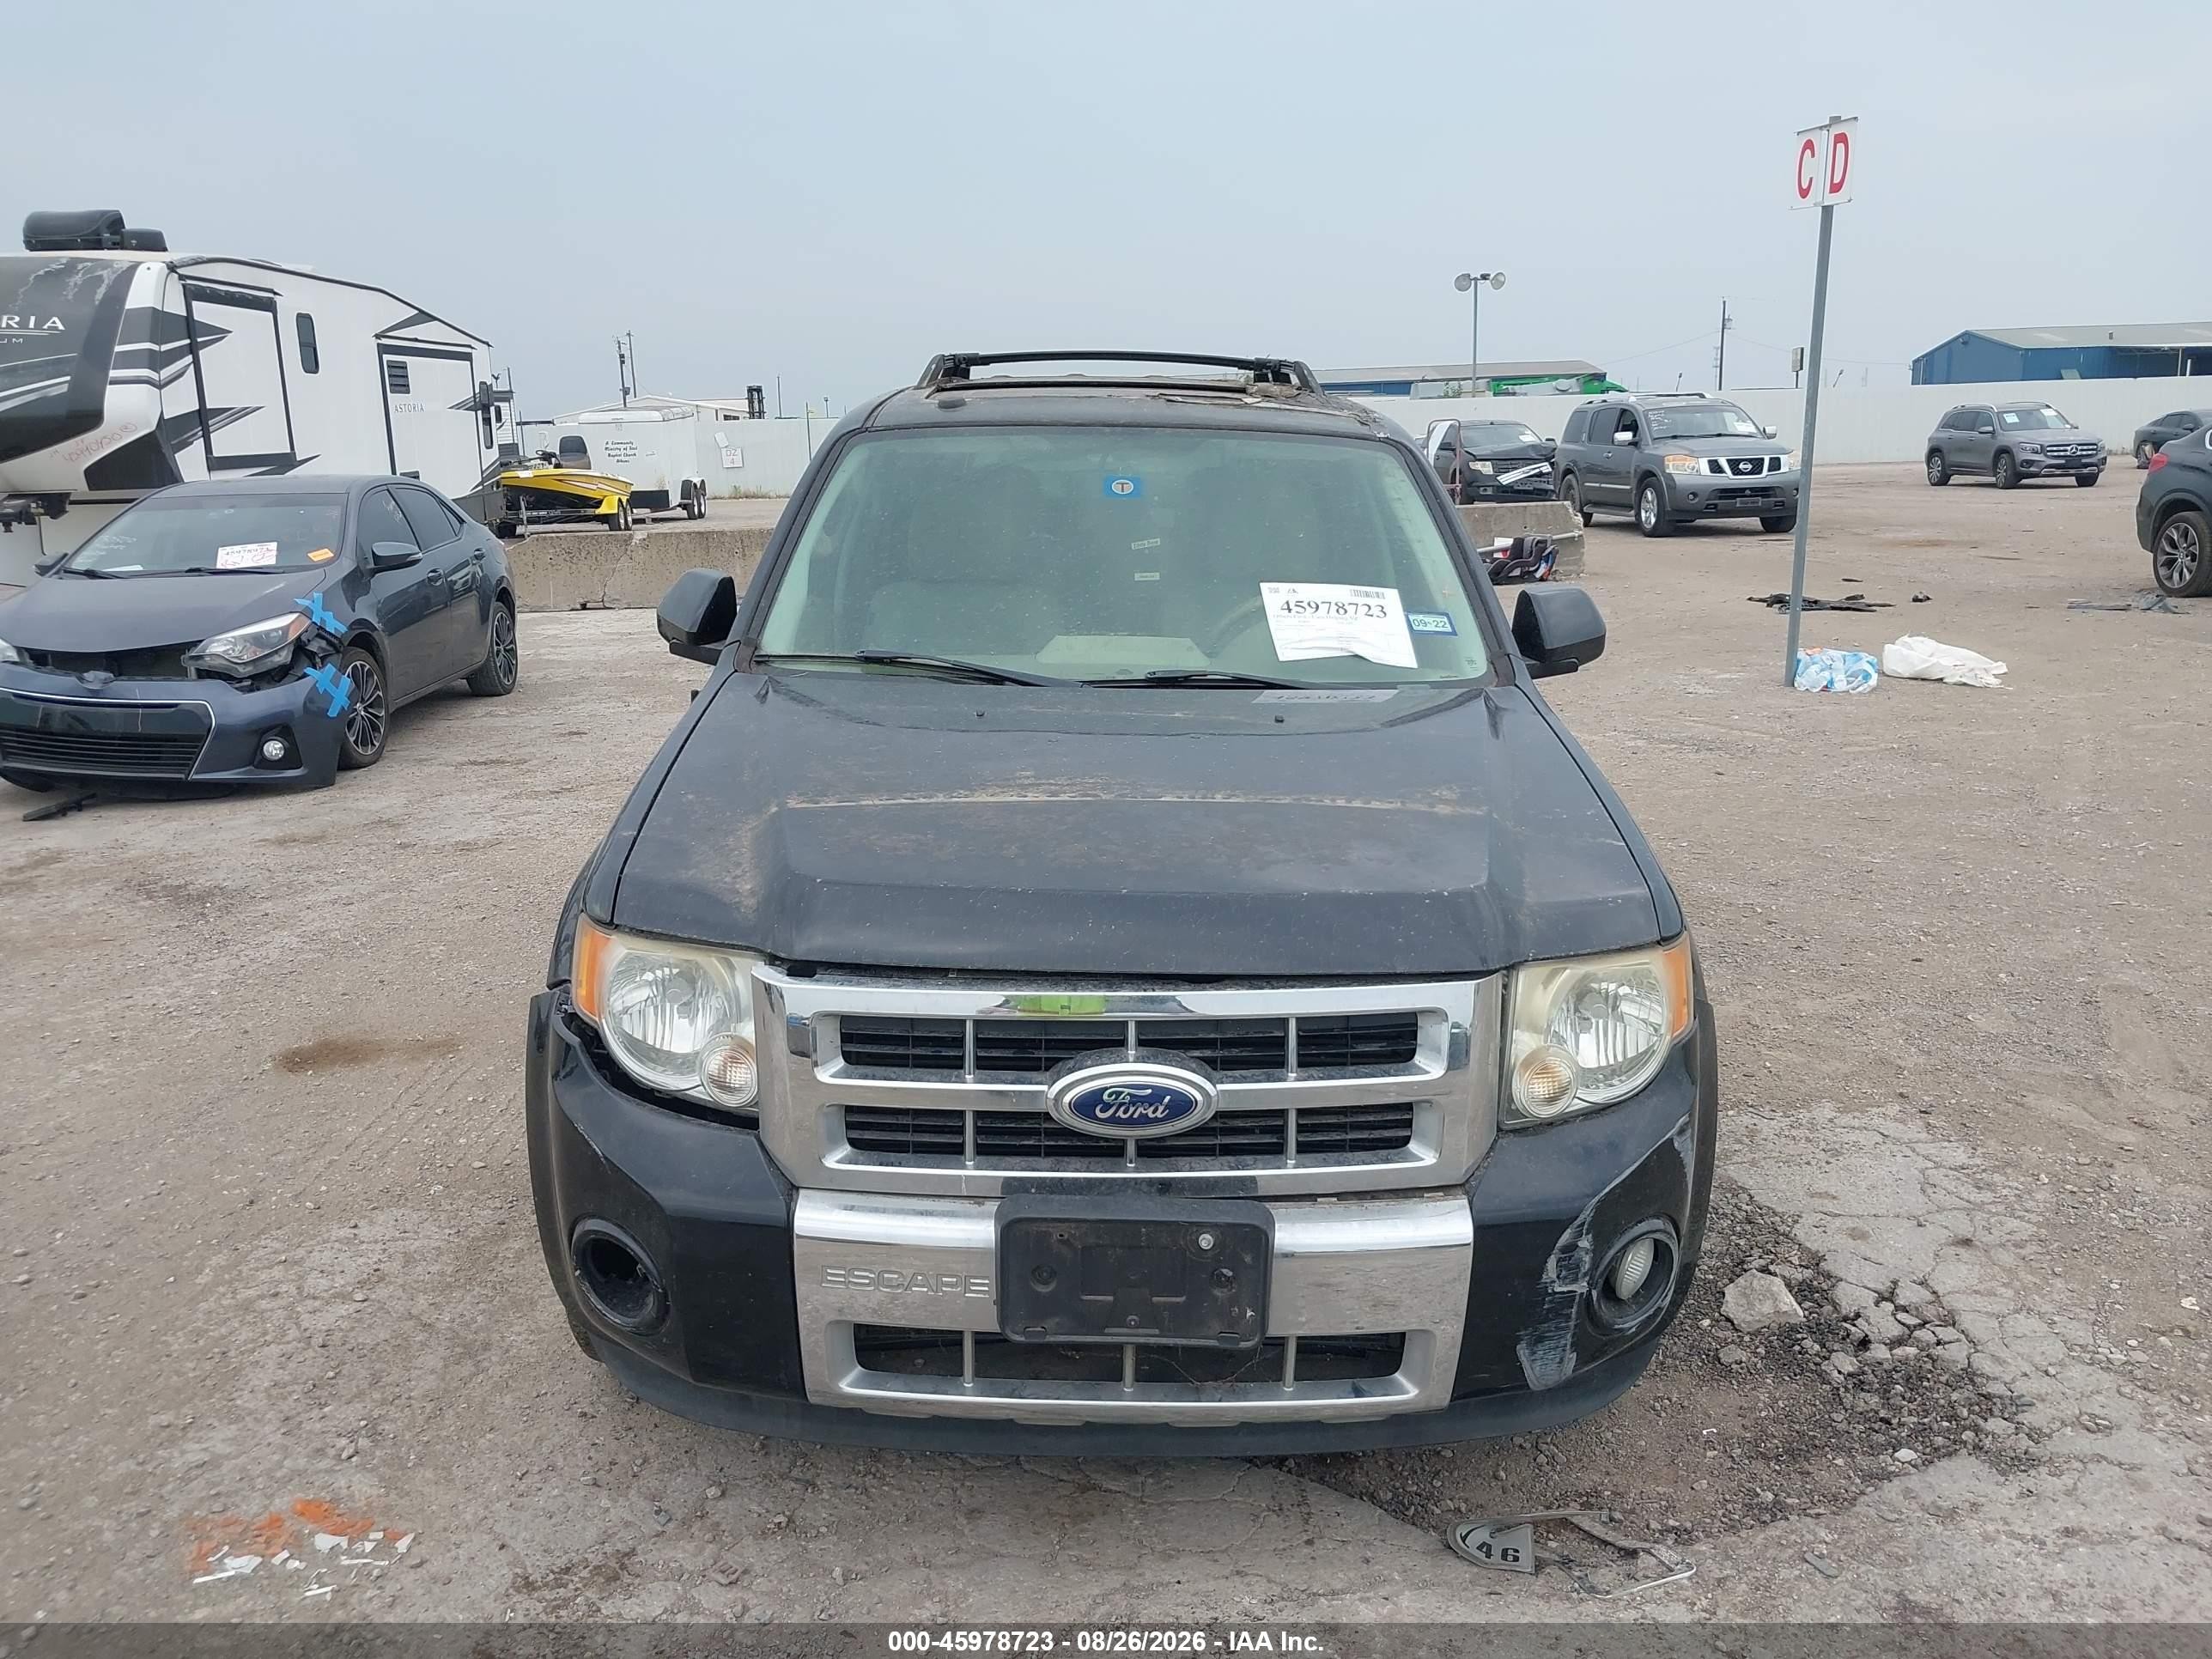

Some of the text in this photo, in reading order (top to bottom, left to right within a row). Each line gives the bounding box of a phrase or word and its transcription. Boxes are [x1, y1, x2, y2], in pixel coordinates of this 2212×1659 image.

[1797, 138, 1815, 199] C
[1828, 132, 1850, 194] D
[394, 404, 425, 412] ASTORIA
[1280, 600, 1387, 618] 45978723
[1413, 618, 1449, 629] 09 22
[1095, 1087, 1171, 1119] Ford
[820, 1265, 990, 1297] ESCAPE
